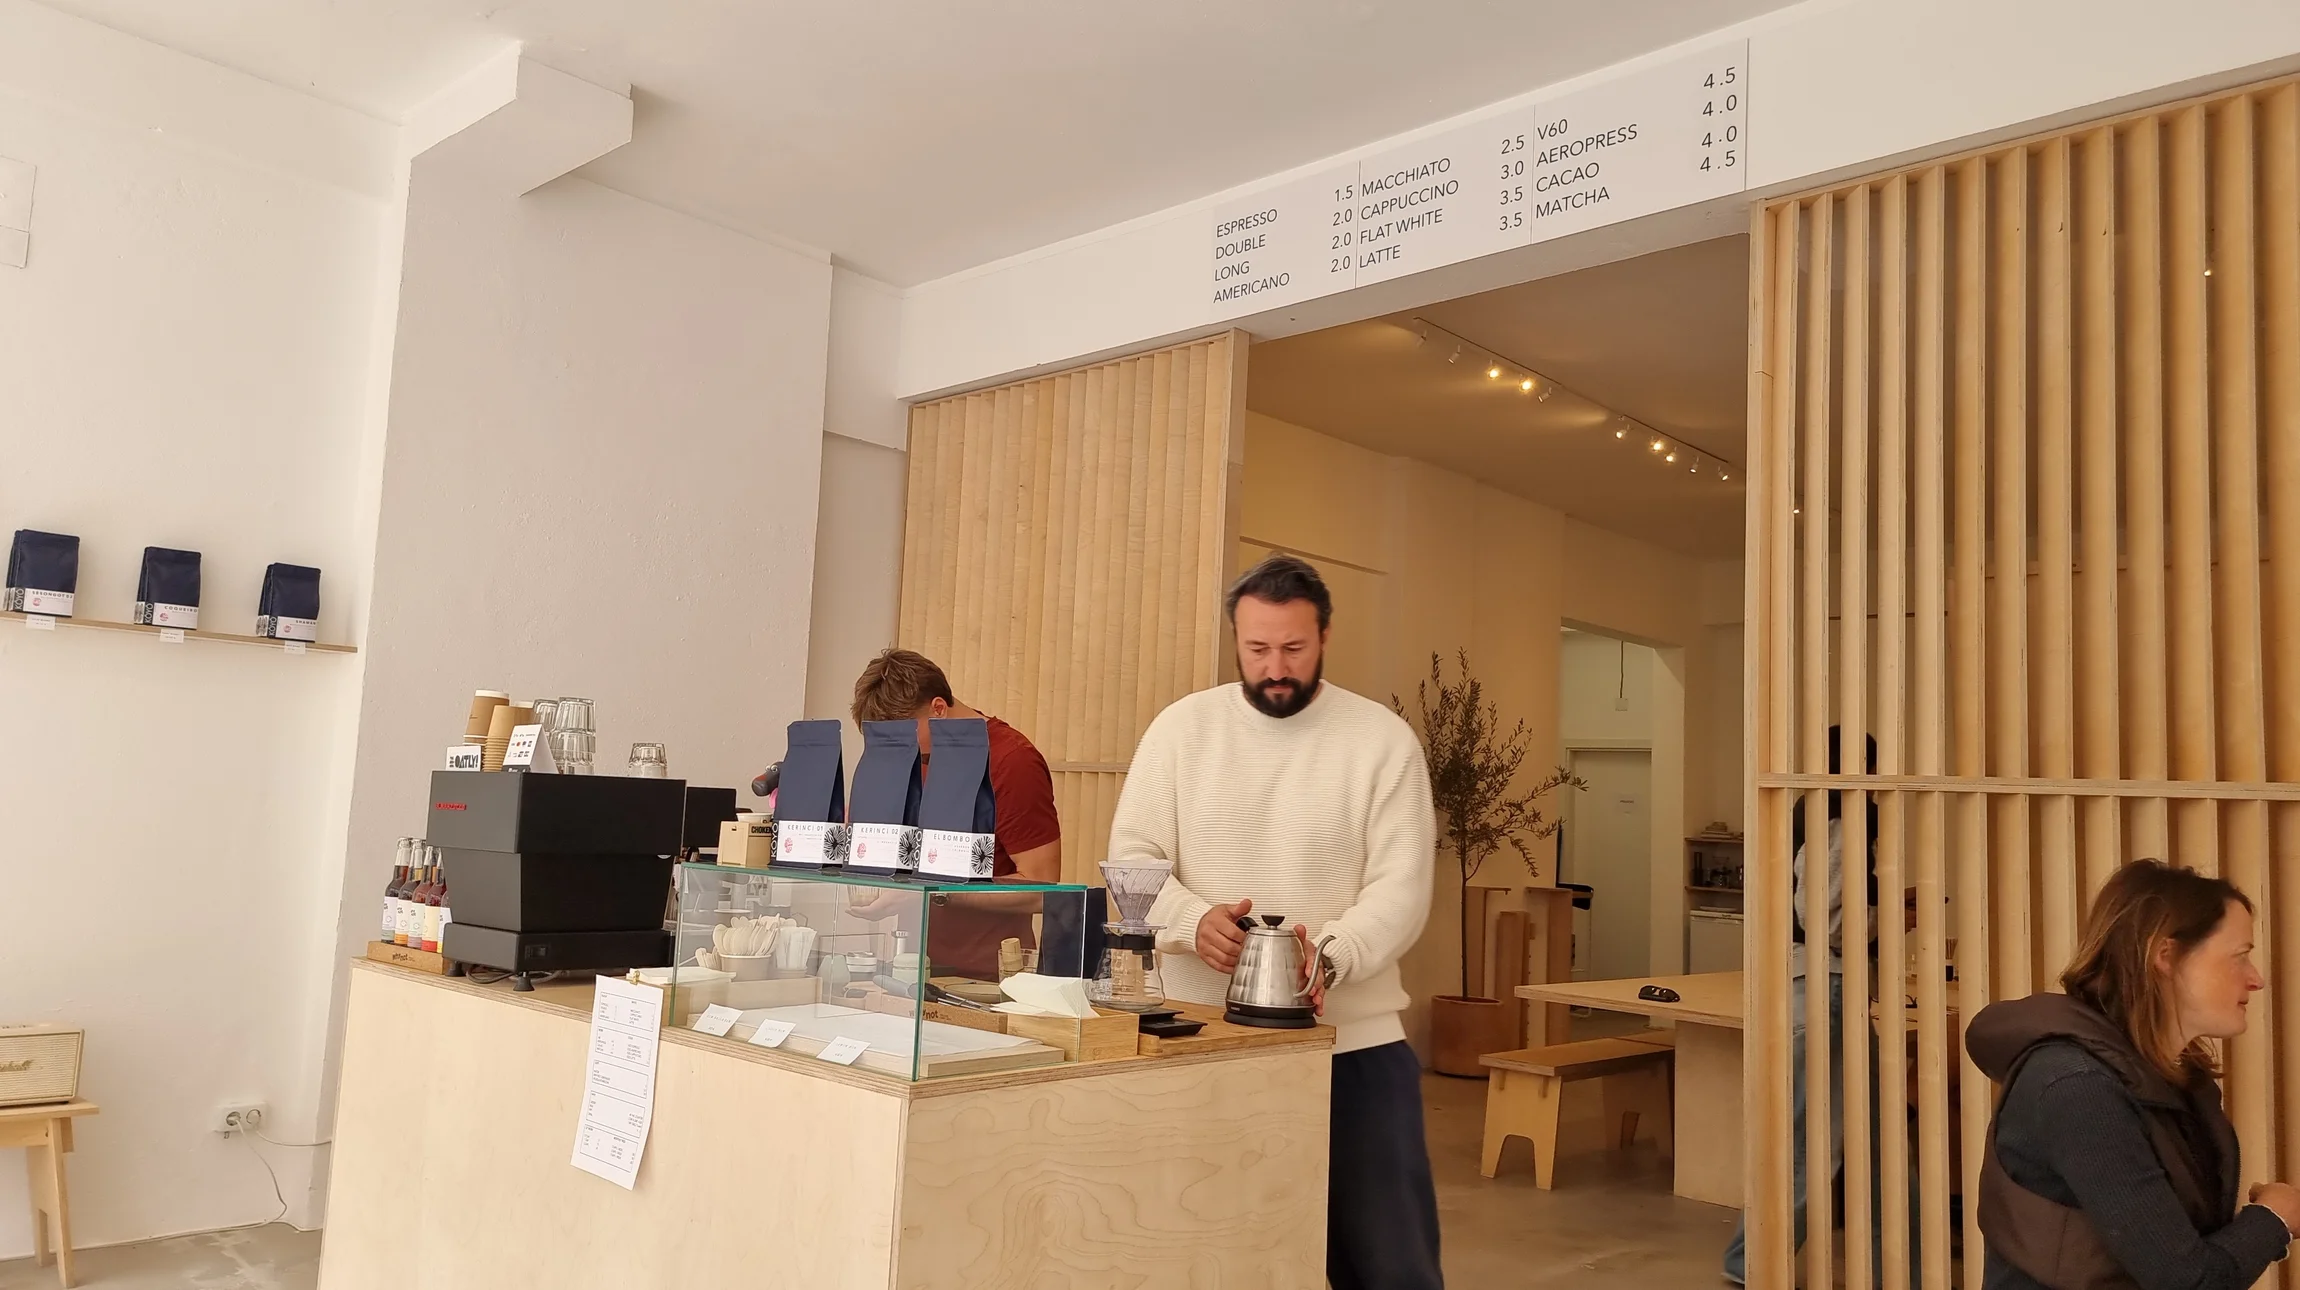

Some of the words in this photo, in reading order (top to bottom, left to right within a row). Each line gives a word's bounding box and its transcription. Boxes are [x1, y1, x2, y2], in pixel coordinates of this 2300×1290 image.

[1702, 66, 1738, 90] 4.5
[1701, 94, 1739, 117] 4.0
[1536, 118, 1569, 141] V60
[1700, 125, 1739, 148] 4.0
[1501, 134, 1526, 156] 2.5
[1534, 123, 1639, 168] AEROPRESS
[1499, 159, 1525, 180] 3.0
[1699, 149, 1737, 173] 4.5
[1360, 157, 1452, 198] MACCHIATO
[1535, 160, 1601, 194] CACAO
[1334, 184, 1354, 202] 1.5
[1359, 179, 1460, 222] CAPPUCCINO
[1499, 185, 1524, 206] 3.5
[1534, 186, 1611, 220] MATCHA
[1216, 208, 1279, 238] ESPRESSO
[1331, 208, 1354, 228] 2.0
[1359, 222, 1395, 245] FLAT
[1395, 208, 1444, 234] WHITE
[1498, 211, 1524, 231] 3.5
[1214, 233, 1267, 260] DOUBLE
[1330, 231, 1353, 250] 2.0
[1329, 255, 1352, 274] 2.0
[1358, 244, 1402, 269] LATTE
[1213, 259, 1251, 282] LONG
[1212, 272, 1290, 304] AMERICANO
[455, 754, 478, 769] OATLY!
[860, 826, 889, 834] KERINCI
[942, 834, 971, 843] BOMBO
